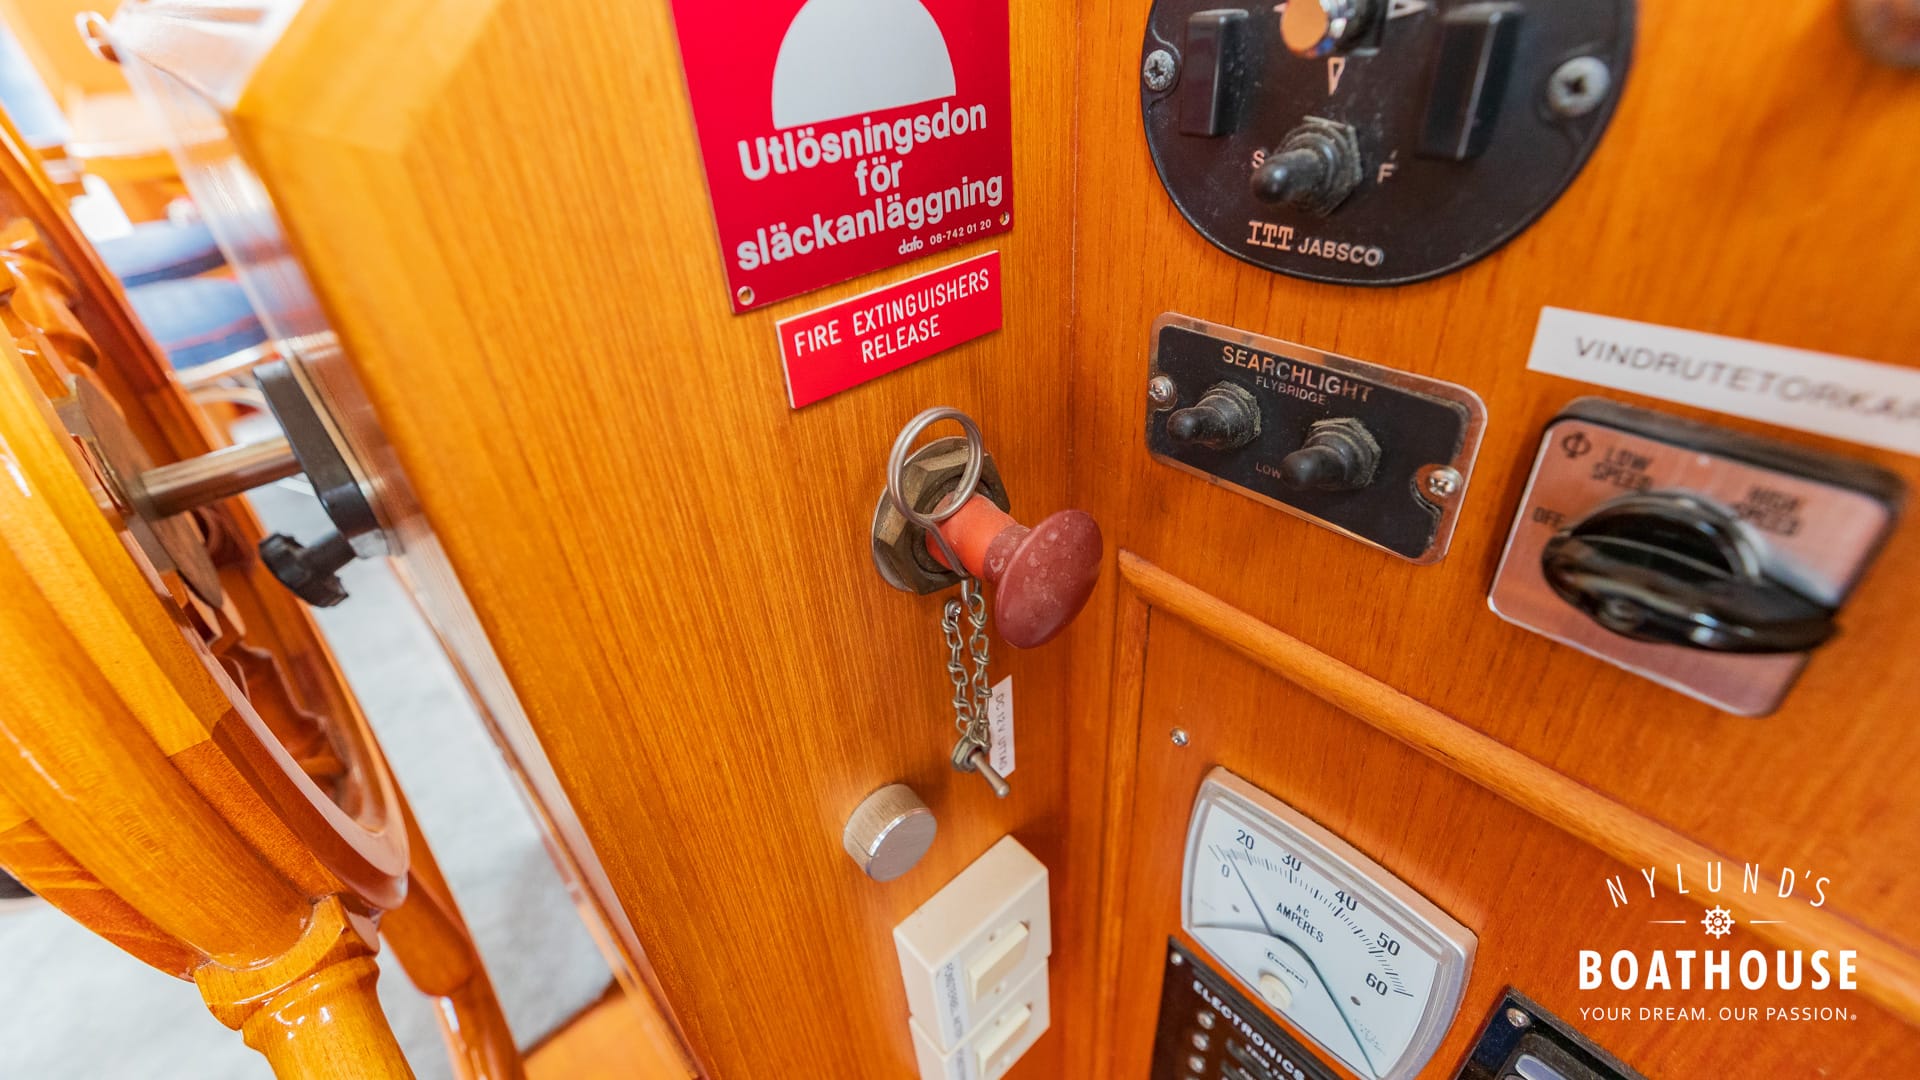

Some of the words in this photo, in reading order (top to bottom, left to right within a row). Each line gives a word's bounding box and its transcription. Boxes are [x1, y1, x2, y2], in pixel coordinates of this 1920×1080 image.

[737, 102, 987, 181] Utlösningsdon
[1252, 149, 1265, 169] S
[1377, 162, 1395, 184] F
[855, 157, 903, 196] för
[736, 175, 1003, 270] släckanläggning
[898, 235, 924, 255] dafo
[929, 227, 964, 246] 08-742
[966, 223, 977, 234] 01
[980, 219, 992, 231] 20
[1246, 220, 1295, 251] ITT
[1297, 238, 1384, 266] JABSCO
[794, 320, 841, 357] FIRE
[853, 269, 989, 335] EXTINGUISHERS
[861, 315, 940, 363] RELEASE
[1222, 346, 1374, 403] SEARCHLIGHT
[1255, 376, 1327, 406] FLYBRIDGE
[1255, 462, 1281, 479] LOW
[1236, 828, 1256, 851] 20
[1220, 864, 1230, 878] 0
[1281, 854, 1302, 872] 30
[1334, 888, 1358, 912] 40
[1275, 901, 1324, 943] AMPERES
[1376, 932, 1401, 957] 50
[1365, 972, 1389, 997] 60
[1192, 980, 1305, 1080] ELECTRONICS
